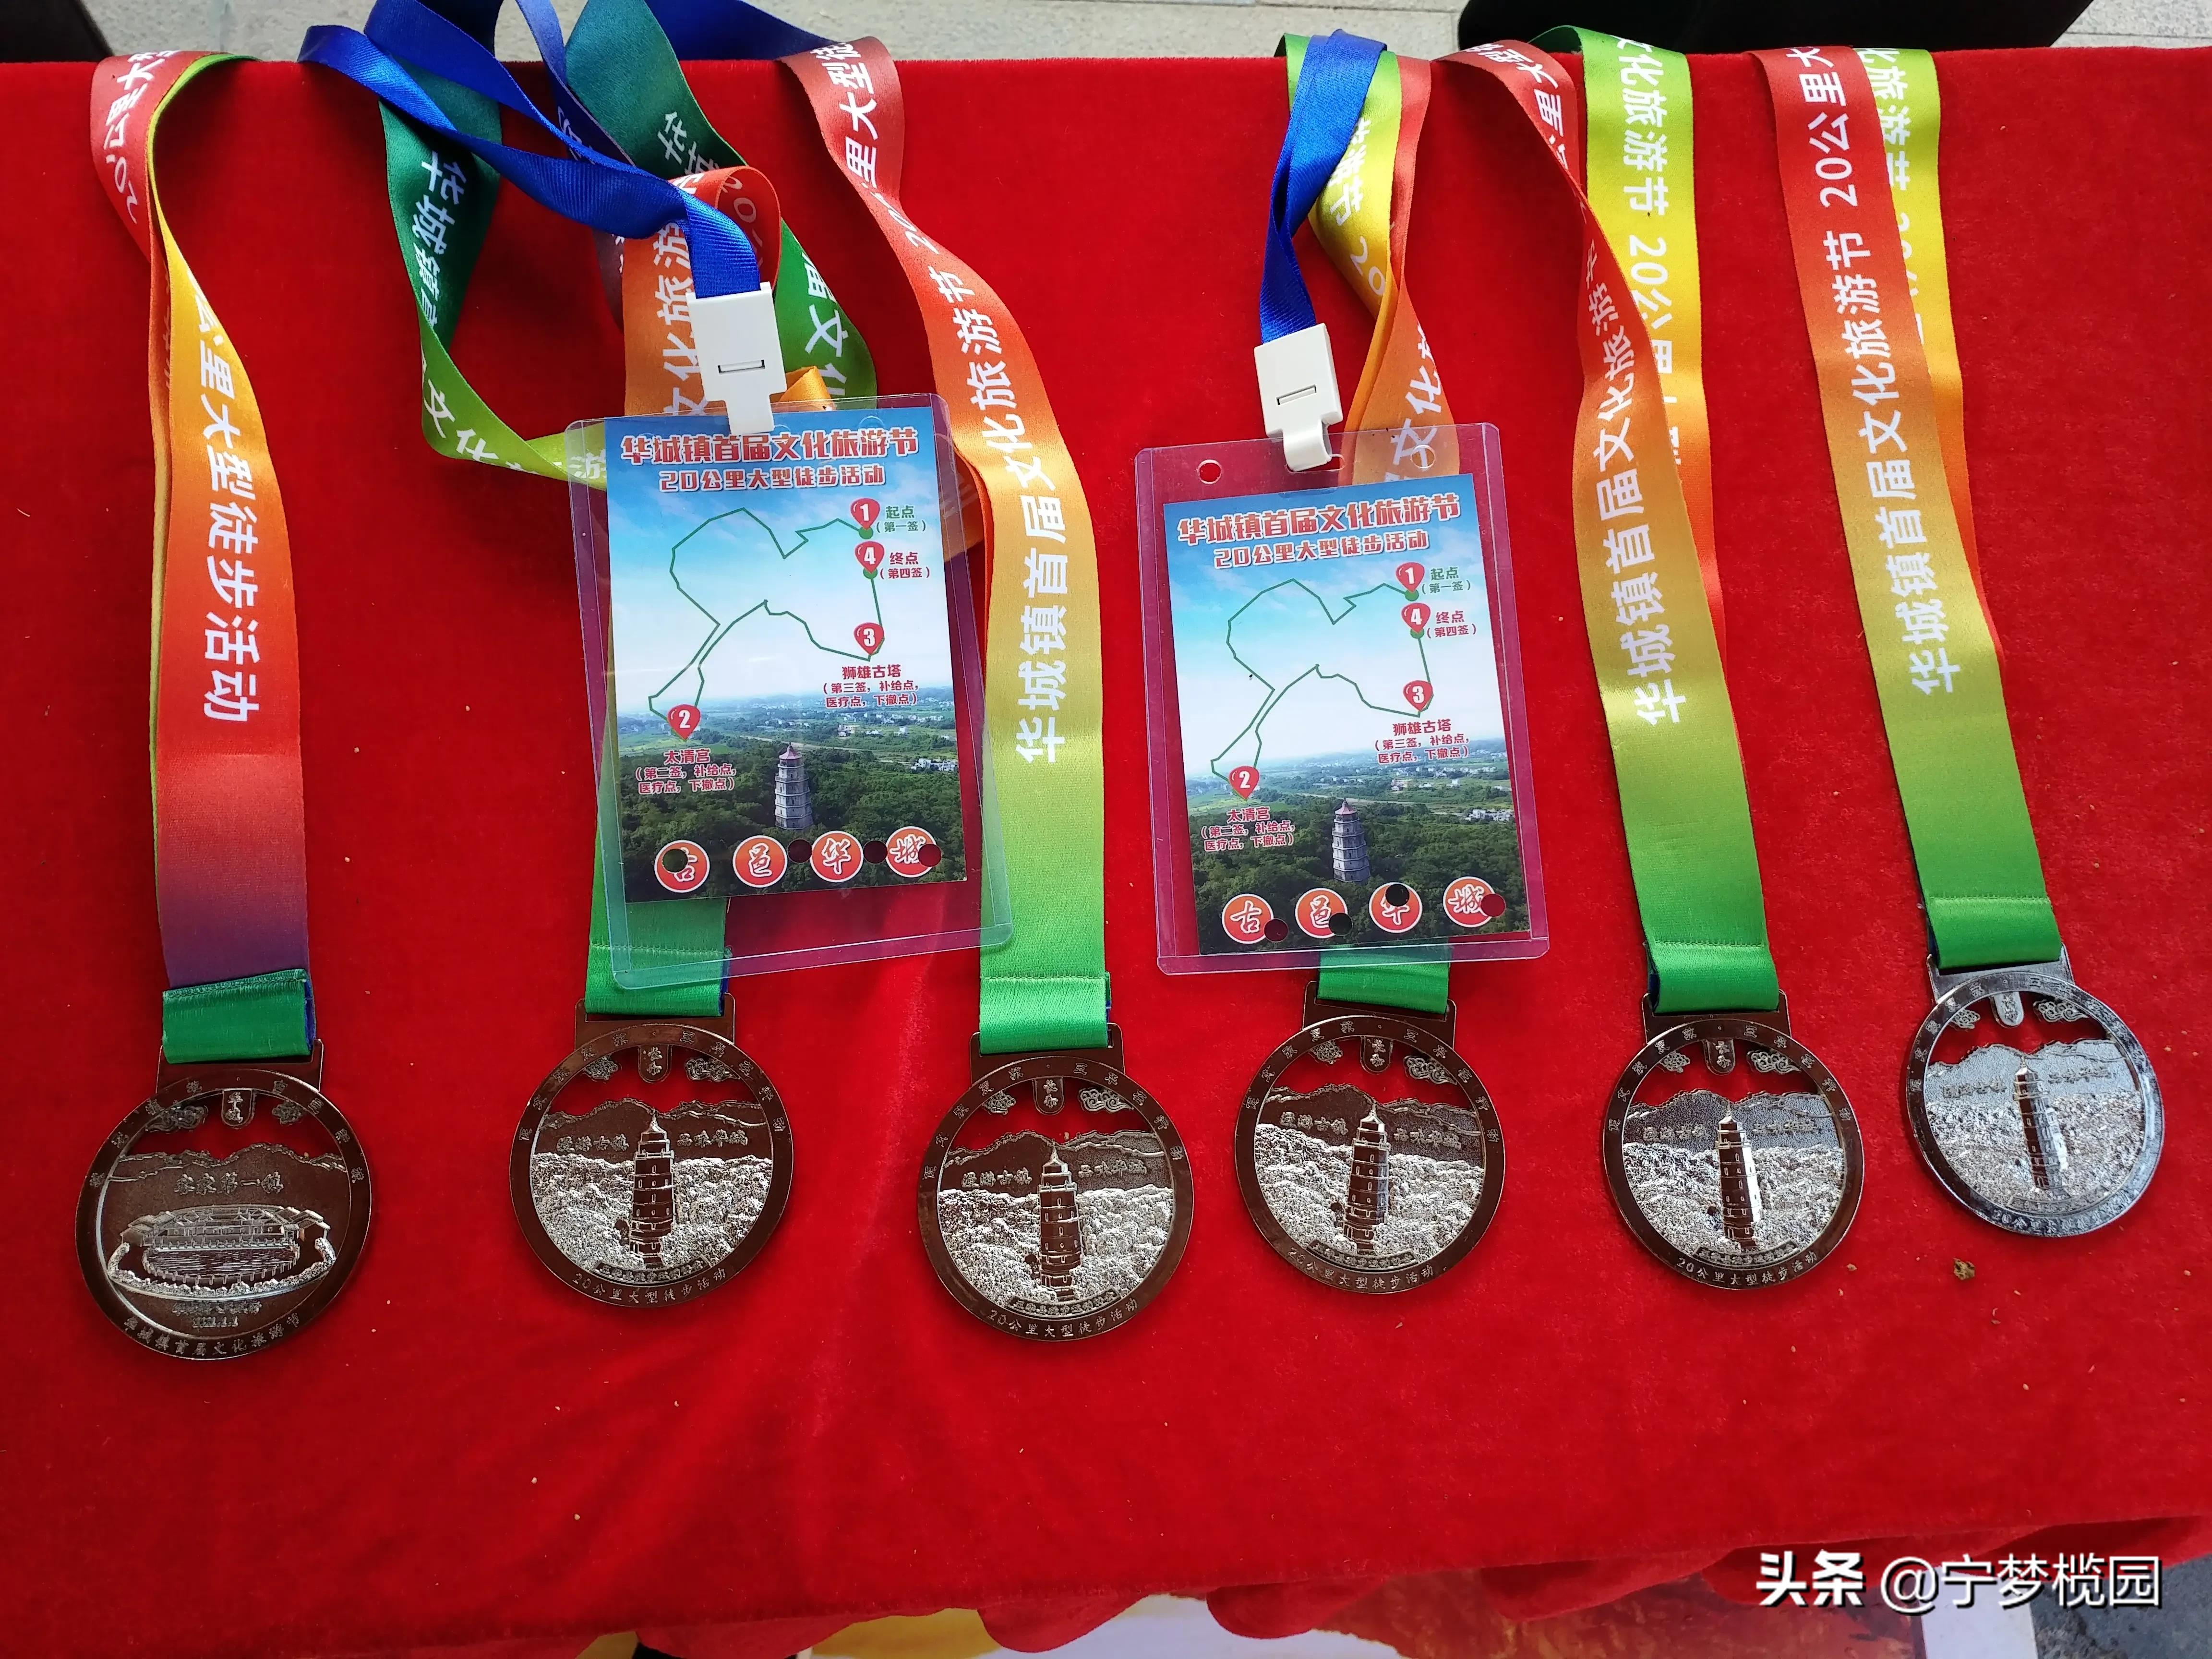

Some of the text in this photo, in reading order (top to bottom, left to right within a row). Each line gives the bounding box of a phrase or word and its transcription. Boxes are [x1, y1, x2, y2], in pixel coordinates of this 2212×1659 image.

[621, 428, 919, 464] 华城镇首届文化旅游节
[1822, 230, 1960, 695] 华城镇首届文化旅游节
[659, 465, 885, 493] 20公里大型徒步活动
[860, 504, 869, 522] 1
[885, 505, 915, 519] 起点
[928, 265, 1069, 762] 华城镇首届文化旅游节
[1178, 493, 1461, 545] 华城镇首届文化旅游节
[864, 546, 875, 564] 4
[1213, 529, 1429, 569] 20公里大型徒步活动
[890, 552, 919, 565] 终点
[1405, 568, 1415, 585] 1
[1430, 566, 1460, 580] 起点
[1411, 608, 1421, 625] 4
[1436, 611, 1465, 624] 终点
[864, 628, 876, 647] 3
[842, 664, 902, 680] 狮雄古塔
[1413, 686, 1424, 704] 3
[678, 710, 691, 728] 2
[1393, 719, 1452, 736] 狮雄古塔
[663, 748, 710, 764] 太清宫
[1239, 771, 1250, 788] 2
[1227, 806, 1270, 823] 太清宫
[572, 1270, 728, 1304] 20公里大型徒步活动
[986, 1298, 1140, 1338] 20公里大型徒步活动
